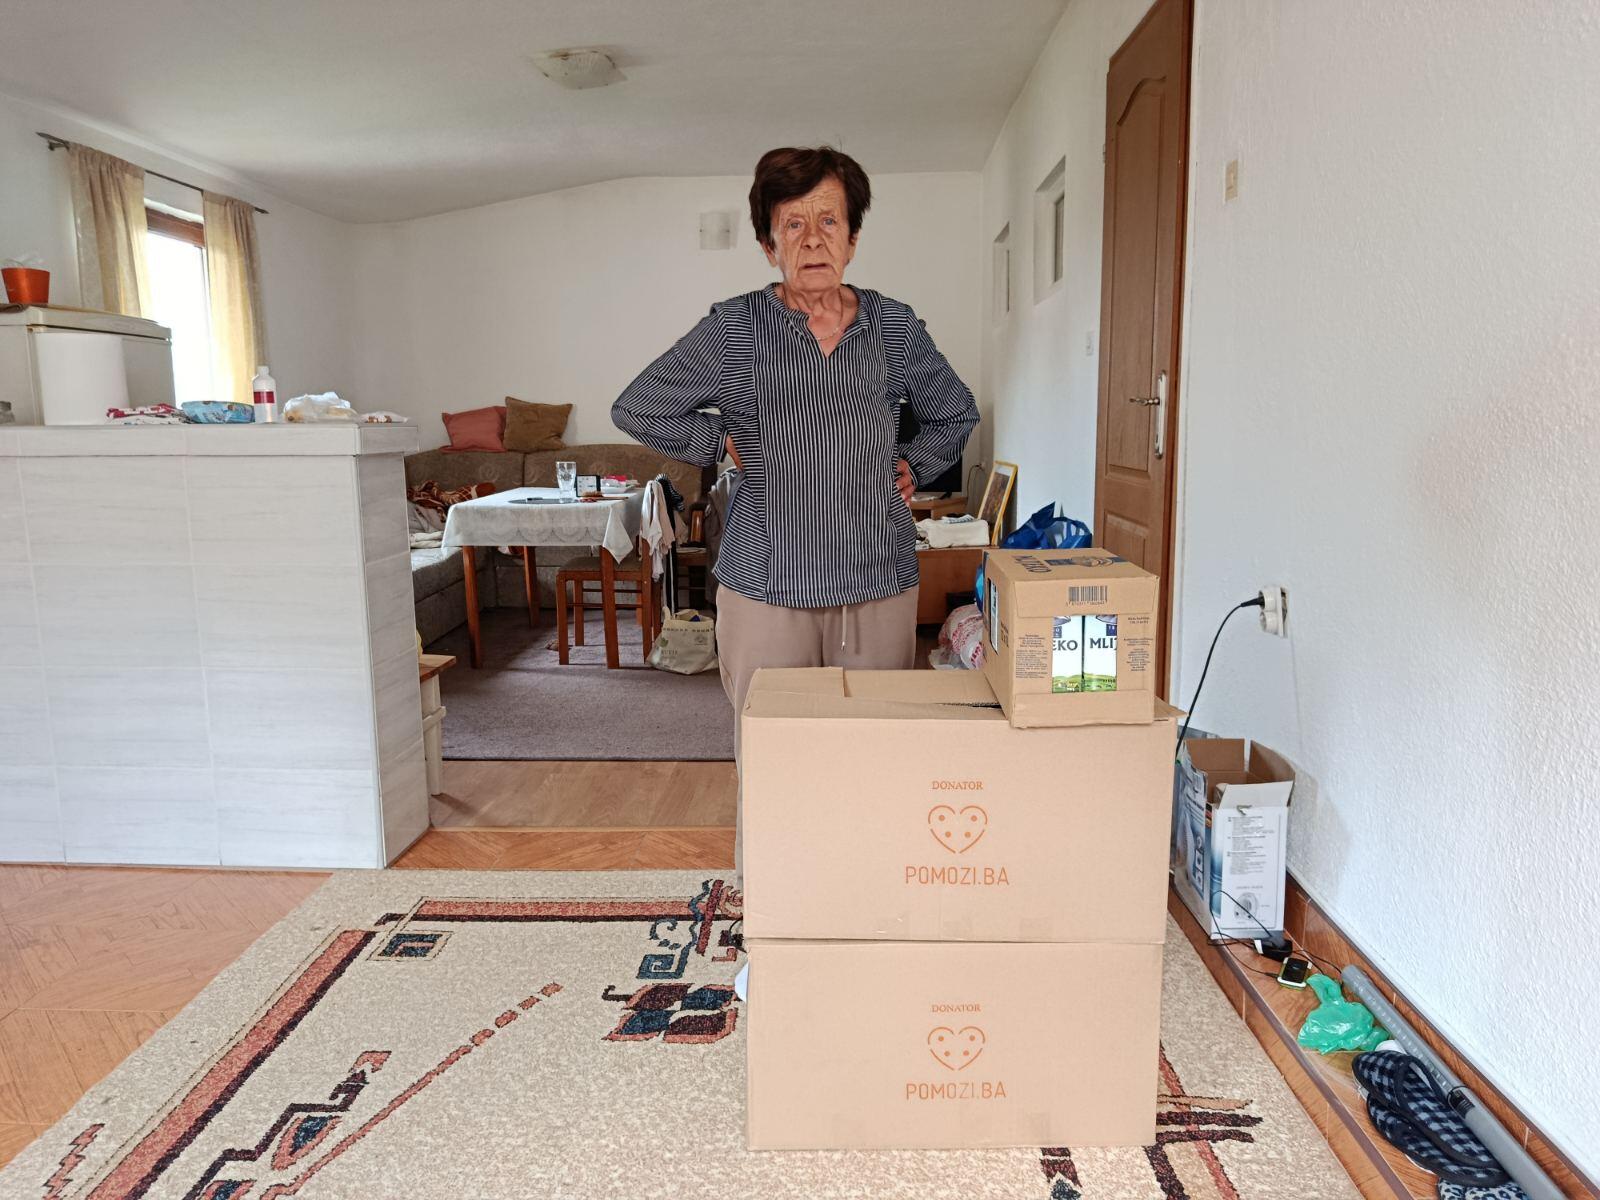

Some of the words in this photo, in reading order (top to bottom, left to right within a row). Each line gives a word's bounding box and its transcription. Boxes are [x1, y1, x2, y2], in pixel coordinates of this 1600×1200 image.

[932, 780, 984, 791] DONATOR
[905, 865, 1010, 886] POMOZI.BA
[931, 1003, 982, 1013] DONATOR
[905, 1080, 1007, 1101] POMOZI.BA
